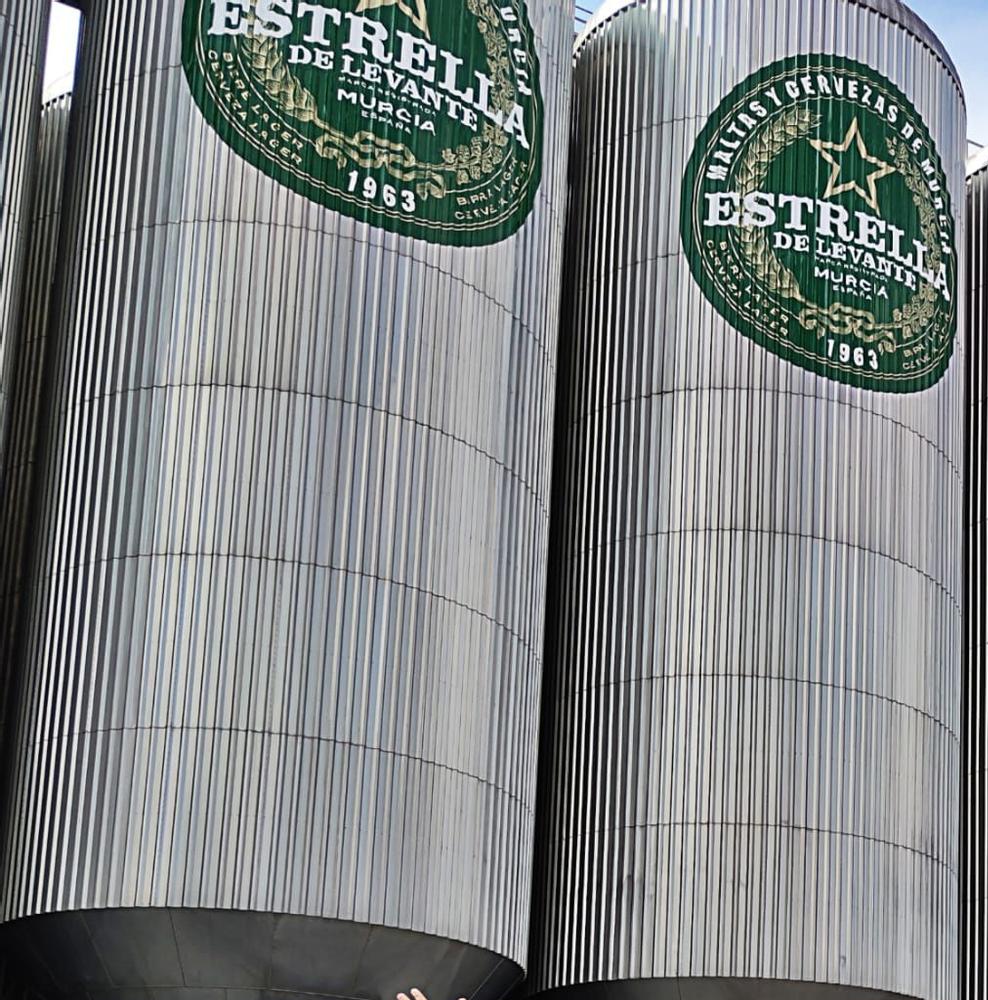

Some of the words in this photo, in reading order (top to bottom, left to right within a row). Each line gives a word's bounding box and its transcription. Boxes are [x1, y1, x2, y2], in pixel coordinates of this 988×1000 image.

[207, 0, 530, 150] ESTRELLA
[500, 5, 532, 96] URCIA
[207, 50, 248, 121] CERVEZA
[248, 123, 303, 165] LAGER
[288, 45, 334, 70] DE
[341, 55, 477, 132] LEVANTE
[337, 88, 436, 136] MURCIA
[251, 103, 304, 149] LAGER
[706, 100, 767, 181] MALTAS
[765, 87, 783, 107] Y
[785, 74, 899, 123] CERVEZAS
[901, 121, 922, 154] DE
[348, 170, 415, 212] 1963
[703, 190, 950, 301] ESTRELLA
[773, 231, 810, 252] DE
[816, 237, 916, 291] LEVANTE
[815, 266, 889, 300] MURCIA
[827, 338, 879, 371] 1963
